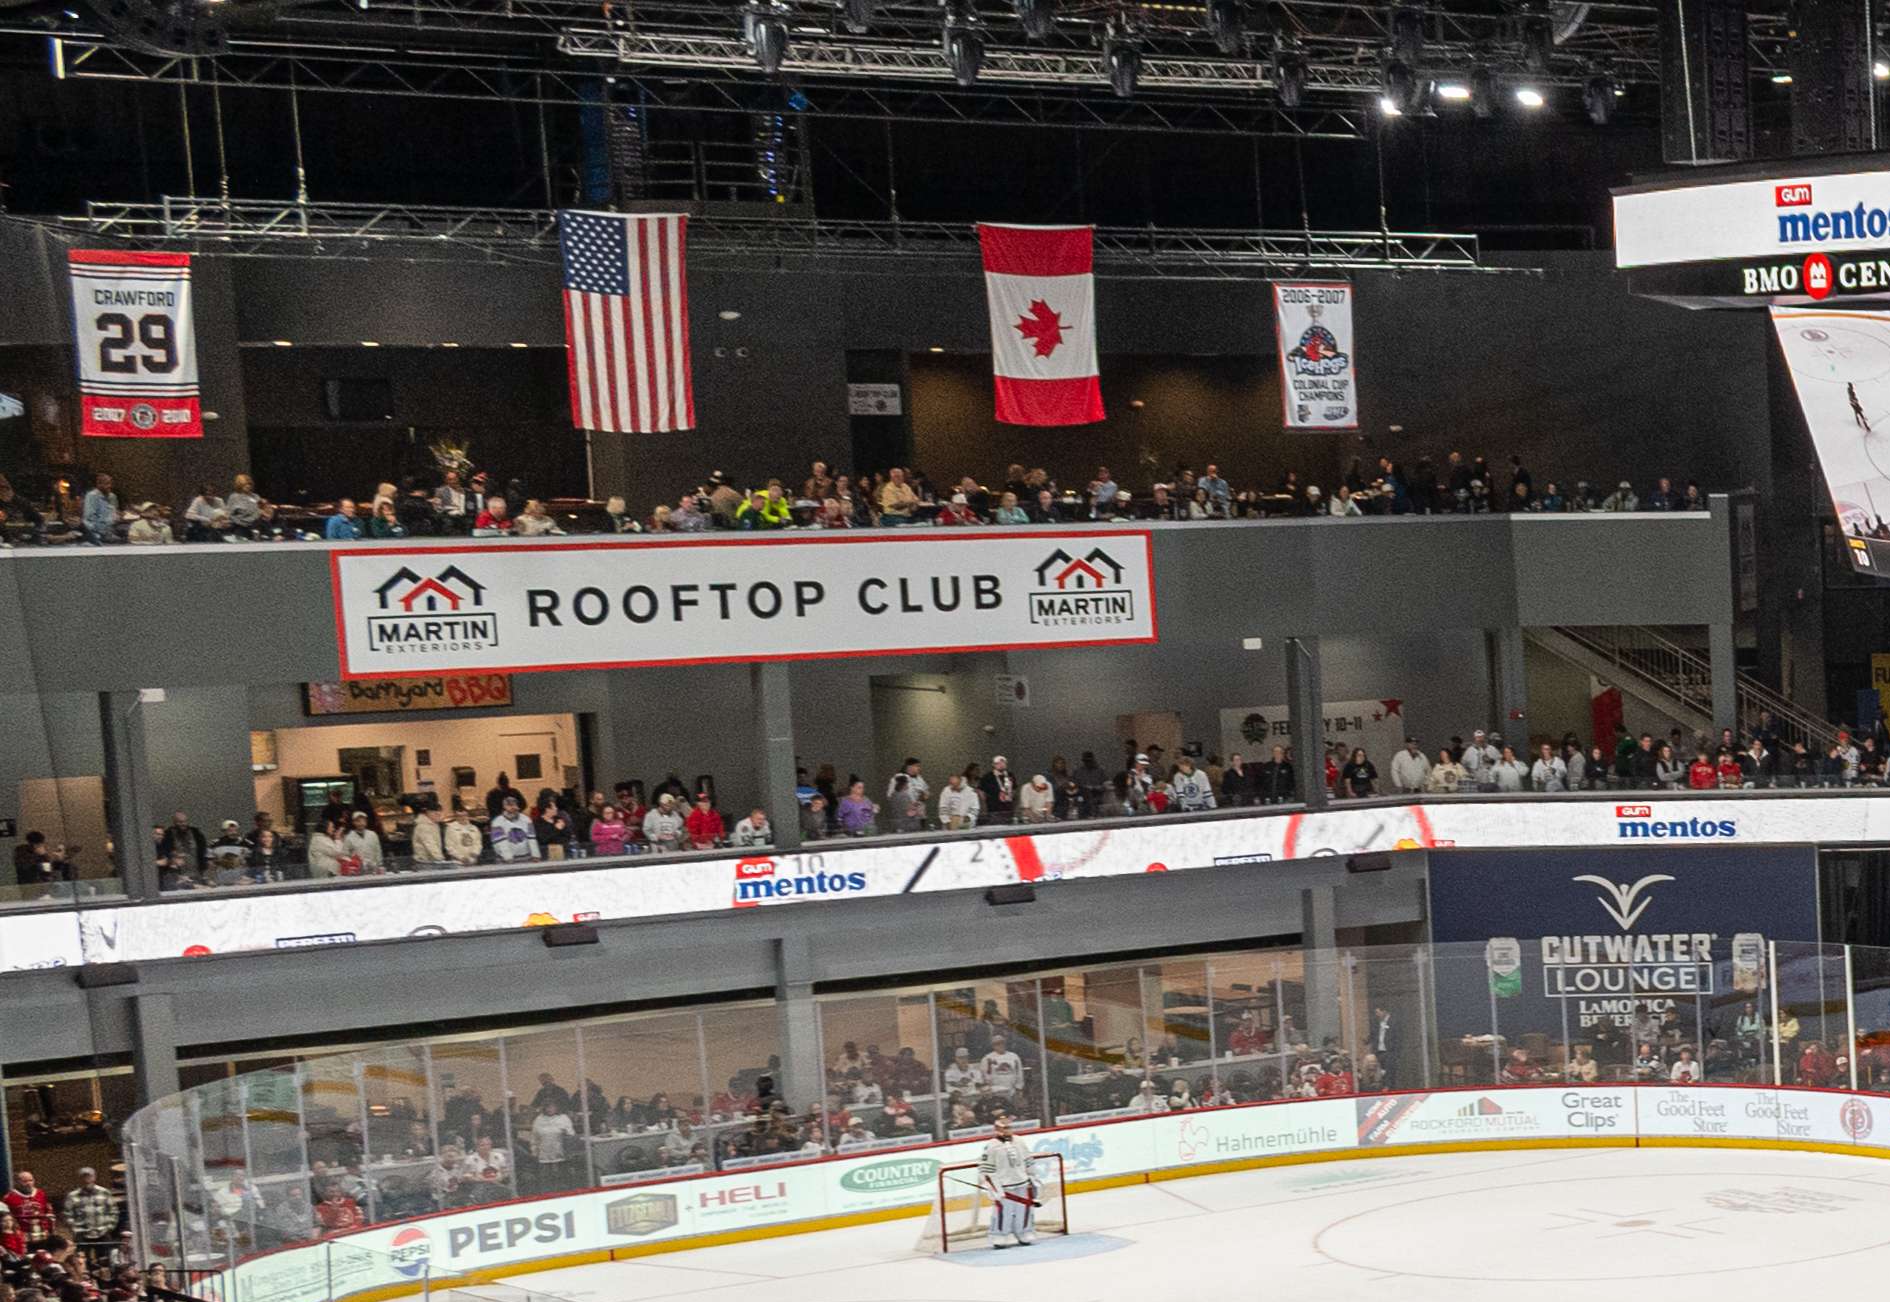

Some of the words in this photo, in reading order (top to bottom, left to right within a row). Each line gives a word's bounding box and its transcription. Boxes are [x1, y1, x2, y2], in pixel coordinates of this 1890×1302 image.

[1743, 263, 1797, 293] BMO
[94, 289, 176, 308] CRAWFORD
[96, 313, 181, 375] 29
[528, 580, 825, 628] ROOFTOP
[858, 574, 1003, 614] CLUB
[1037, 596, 1128, 618] MARTIN
[1042, 614, 1123, 626] EXTERIORS
[378, 621, 489, 645] MARTIN
[386, 641, 484, 655] EXTERIORS
[447, 676, 509, 706] BBQ
[1619, 816, 1735, 838] mentos
[738, 871, 866, 899] mentos
[1542, 933, 1713, 964] CUTWATER
[1556, 966, 1698, 991] LOUNGE
[1561, 1091, 1623, 1109] Great
[1657, 1100, 1697, 1117] Good
[1697, 1101, 1725, 1117] Feet
[1744, 1102, 1782, 1120] Good
[1783, 1103, 1809, 1120] Feet
[1567, 1111, 1616, 1132] Clips
[1692, 1117, 1729, 1133] Store
[1216, 1127, 1337, 1152] Hahnemühle
[855, 1160, 933, 1184] COUNTRY
[699, 1182, 787, 1210] HELI
[449, 1210, 575, 1258] PEPSI
[391, 1244, 430, 1262] PEPSI
